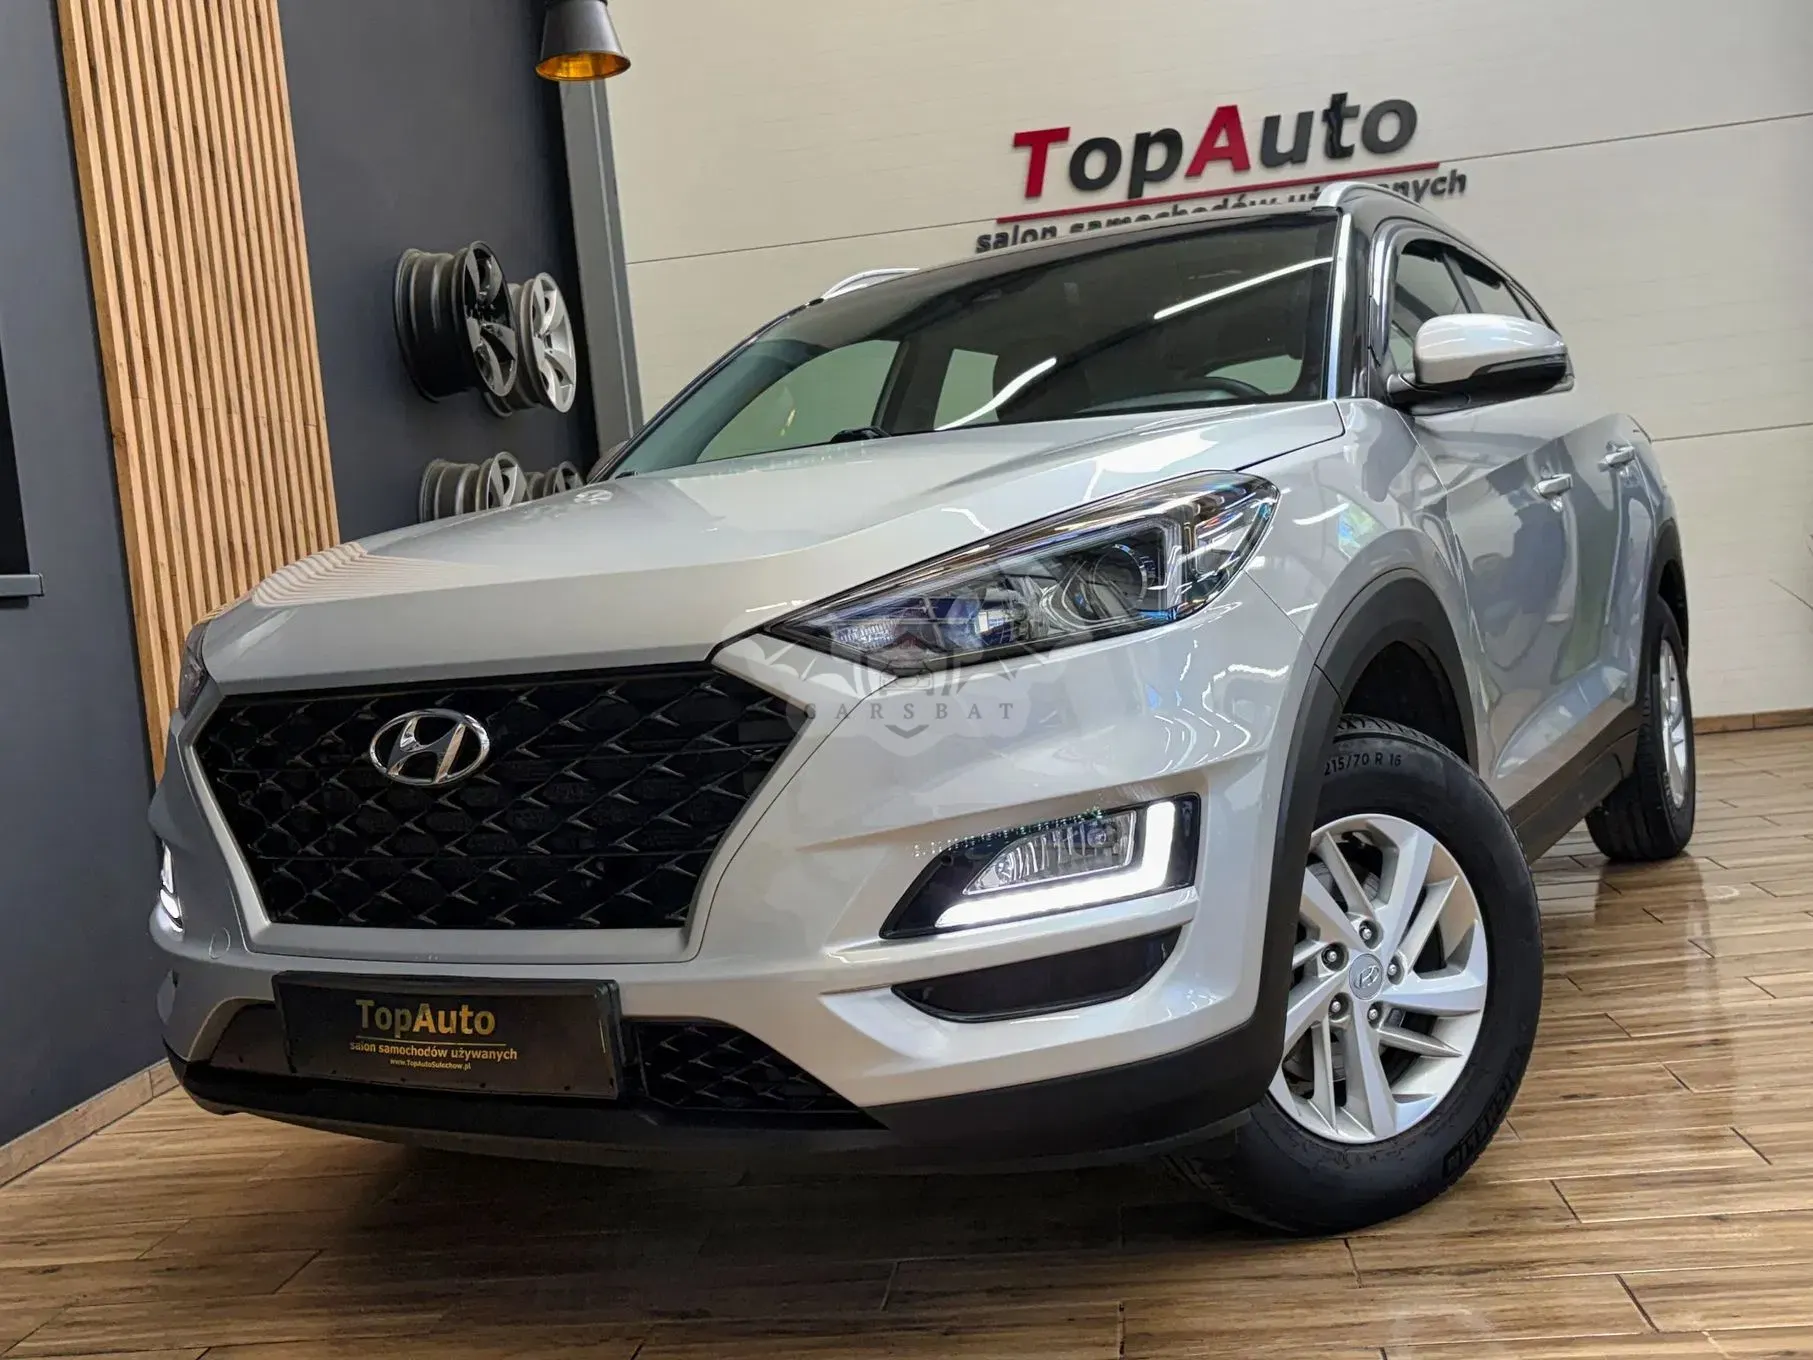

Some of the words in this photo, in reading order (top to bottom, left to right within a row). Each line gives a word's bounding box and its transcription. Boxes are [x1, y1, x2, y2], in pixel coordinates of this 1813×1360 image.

[1012, 92, 1419, 200] TopAuto
[976, 224, 1058, 253] salon
[1374, 751, 1384, 766] R
[1389, 752, 1402, 768] 16
[355, 999, 497, 1038] TopAuto
[349, 1041, 377, 1053] salon
[378, 1044, 448, 1058] samochodów
[450, 1048, 518, 1062] używanych
